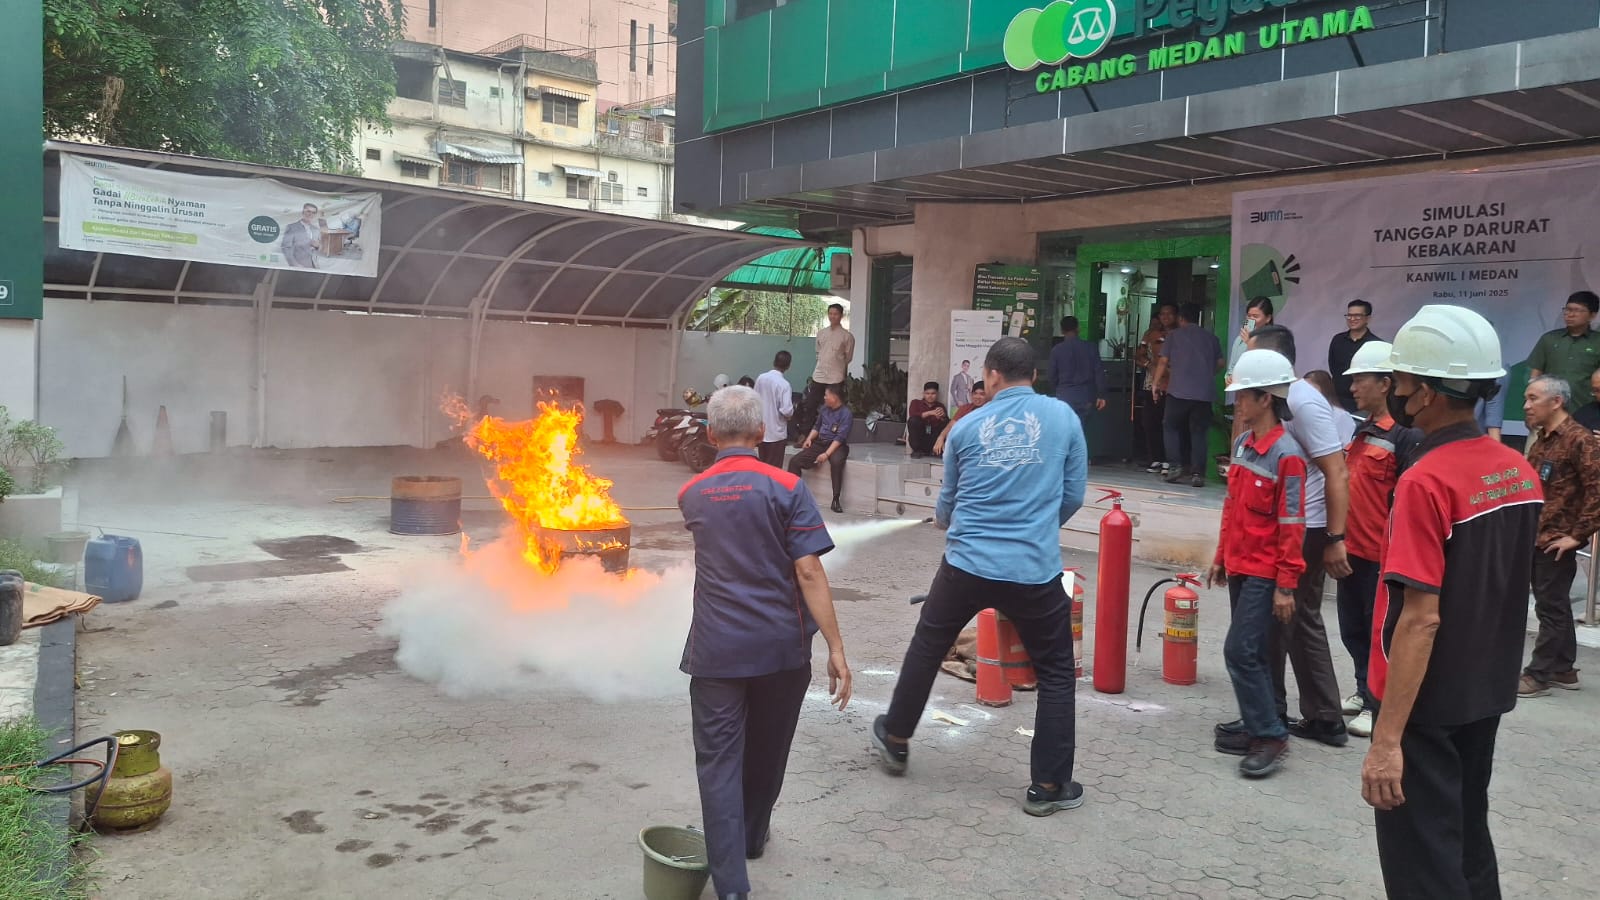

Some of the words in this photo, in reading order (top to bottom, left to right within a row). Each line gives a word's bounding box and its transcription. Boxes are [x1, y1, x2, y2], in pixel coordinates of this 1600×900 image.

[1036, 54, 1138, 93] CABANG
[1148, 31, 1246, 71] MEDAN
[1259, 5, 1375, 49] UTAMA
[92, 188, 121, 198] Gadai
[168, 197, 206, 209] Nyaman
[93, 197, 122, 208] Tanpa
[124, 201, 170, 214] Ninggalin
[172, 208, 204, 218] Urusan
[1422, 202, 1505, 221] SIMULASI
[251, 224, 277, 233] GRATIS
[1374, 225, 1458, 242] TANGGAP
[1463, 218, 1551, 237] DARURAT
[1407, 240, 1516, 259] KEBAKARAN
[1406, 270, 1457, 283] KANWIL
[1461, 270, 1465, 281] I
[1469, 269, 1519, 281] MEDAN
[1433, 291, 1456, 299] Rabu,
[1459, 290, 1468, 298] 11
[1469, 290, 1486, 299] Juni
[1488, 289, 1509, 297] 2025
